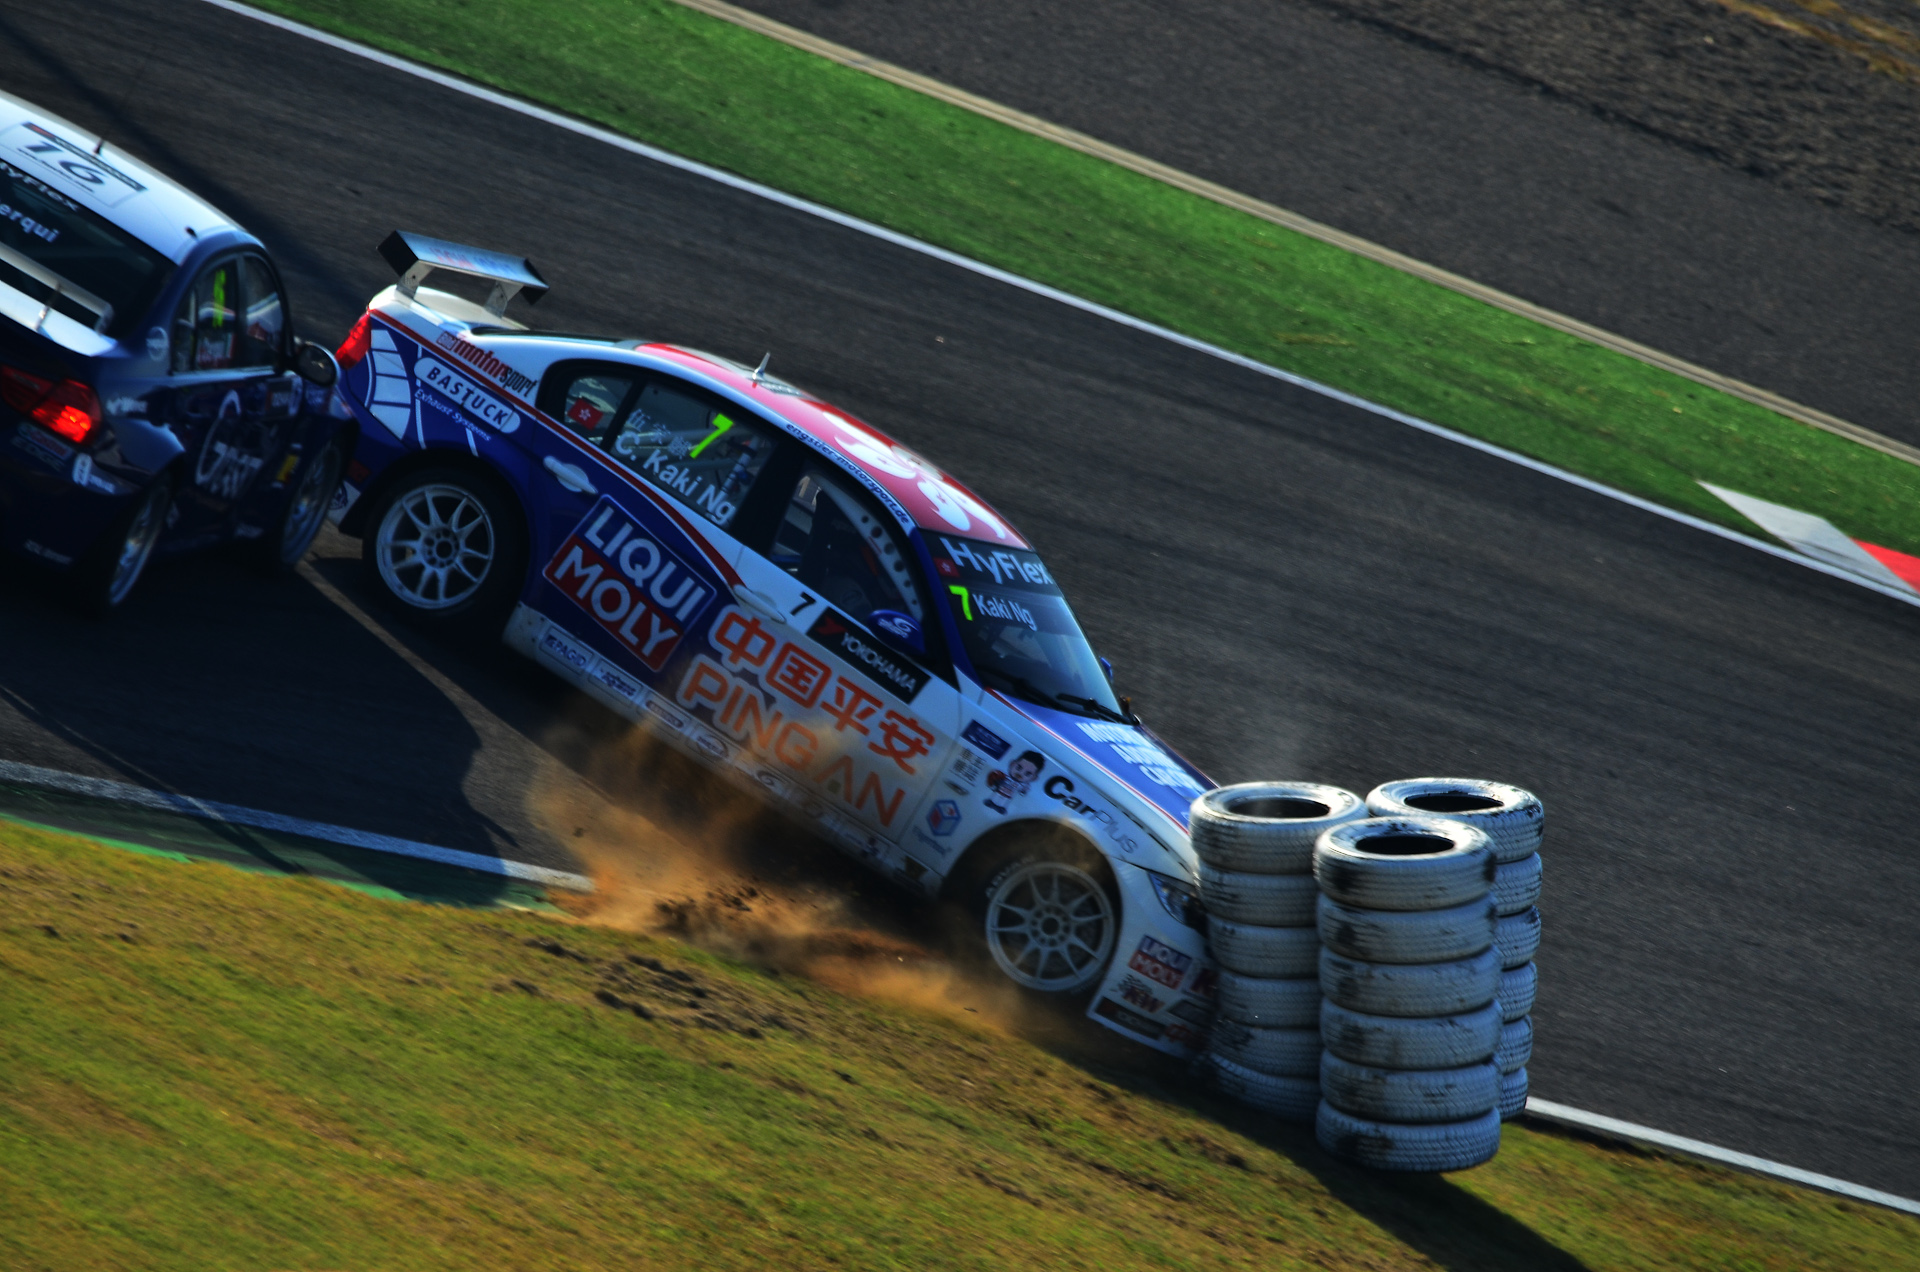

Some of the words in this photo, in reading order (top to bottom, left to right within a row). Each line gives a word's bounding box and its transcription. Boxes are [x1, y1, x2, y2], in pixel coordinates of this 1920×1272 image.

[25, 140, 108, 185] 16
[427, 367, 508, 425] BASTUCK
[453, 337, 538, 397] motorsport
[414, 388, 453, 416] Exhaust
[451, 411, 492, 442] Systems
[689, 413, 734, 459] 7
[615, 431, 640, 461] C.
[642, 449, 703, 497] Kaki
[696, 484, 736, 526] Ng
[786, 423, 909, 524] engstler-motorsport.de
[584, 505, 706, 623] LIQUI
[939, 537, 1054, 585] HyFlex
[553, 543, 679, 657] MOLY
[790, 592, 816, 616] 7
[948, 584, 973, 621] 7
[972, 594, 1010, 619] Kaki
[1011, 603, 1037, 631] Ng
[840, 631, 917, 694] YOKOHAMA
[715, 611, 935, 775] 中国平安
[683, 661, 818, 770] PING
[813, 754, 905, 828] AN
[1044, 775, 1138, 854] CarPlus
[1135, 957, 1184, 989] MOLY
[1141, 939, 1190, 972] LIQUI
